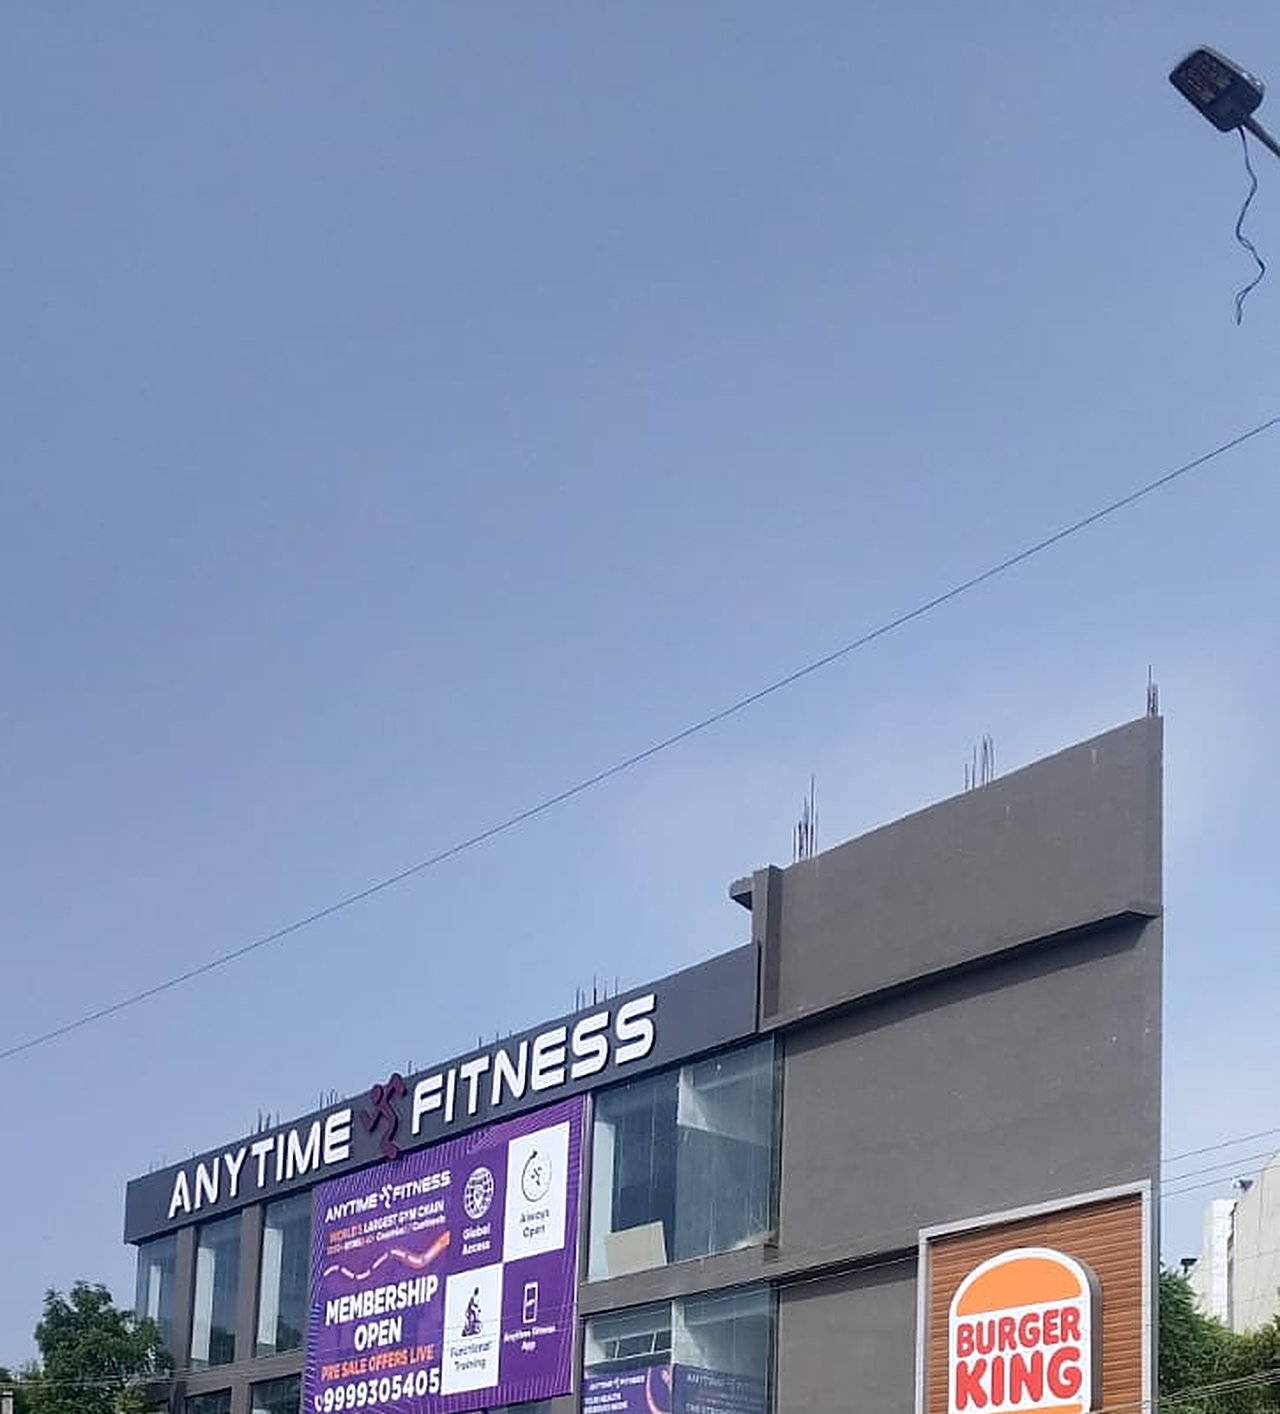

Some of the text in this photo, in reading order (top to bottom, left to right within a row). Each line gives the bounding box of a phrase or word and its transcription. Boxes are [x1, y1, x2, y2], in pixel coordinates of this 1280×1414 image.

[168, 994, 656, 1220] ANYTIME FITNESS
[325, 1170, 452, 1223] ANYTIME FITNESS
[363, 1212, 399, 1234] LARGEST
[418, 1199, 445, 1218] CHAIN
[462, 1222, 492, 1241] Global
[462, 1239, 492, 1256] Access
[325, 1274, 438, 1327] MEMBERSHIP
[354, 1315, 402, 1352] OPEN
[956, 1306, 1082, 1358] BURGER
[321, 1343, 435, 1381] PRE SALE OFFERS LIVE
[955, 1346, 1083, 1411] KING
[323, 1367, 440, 1413] 9999305405
